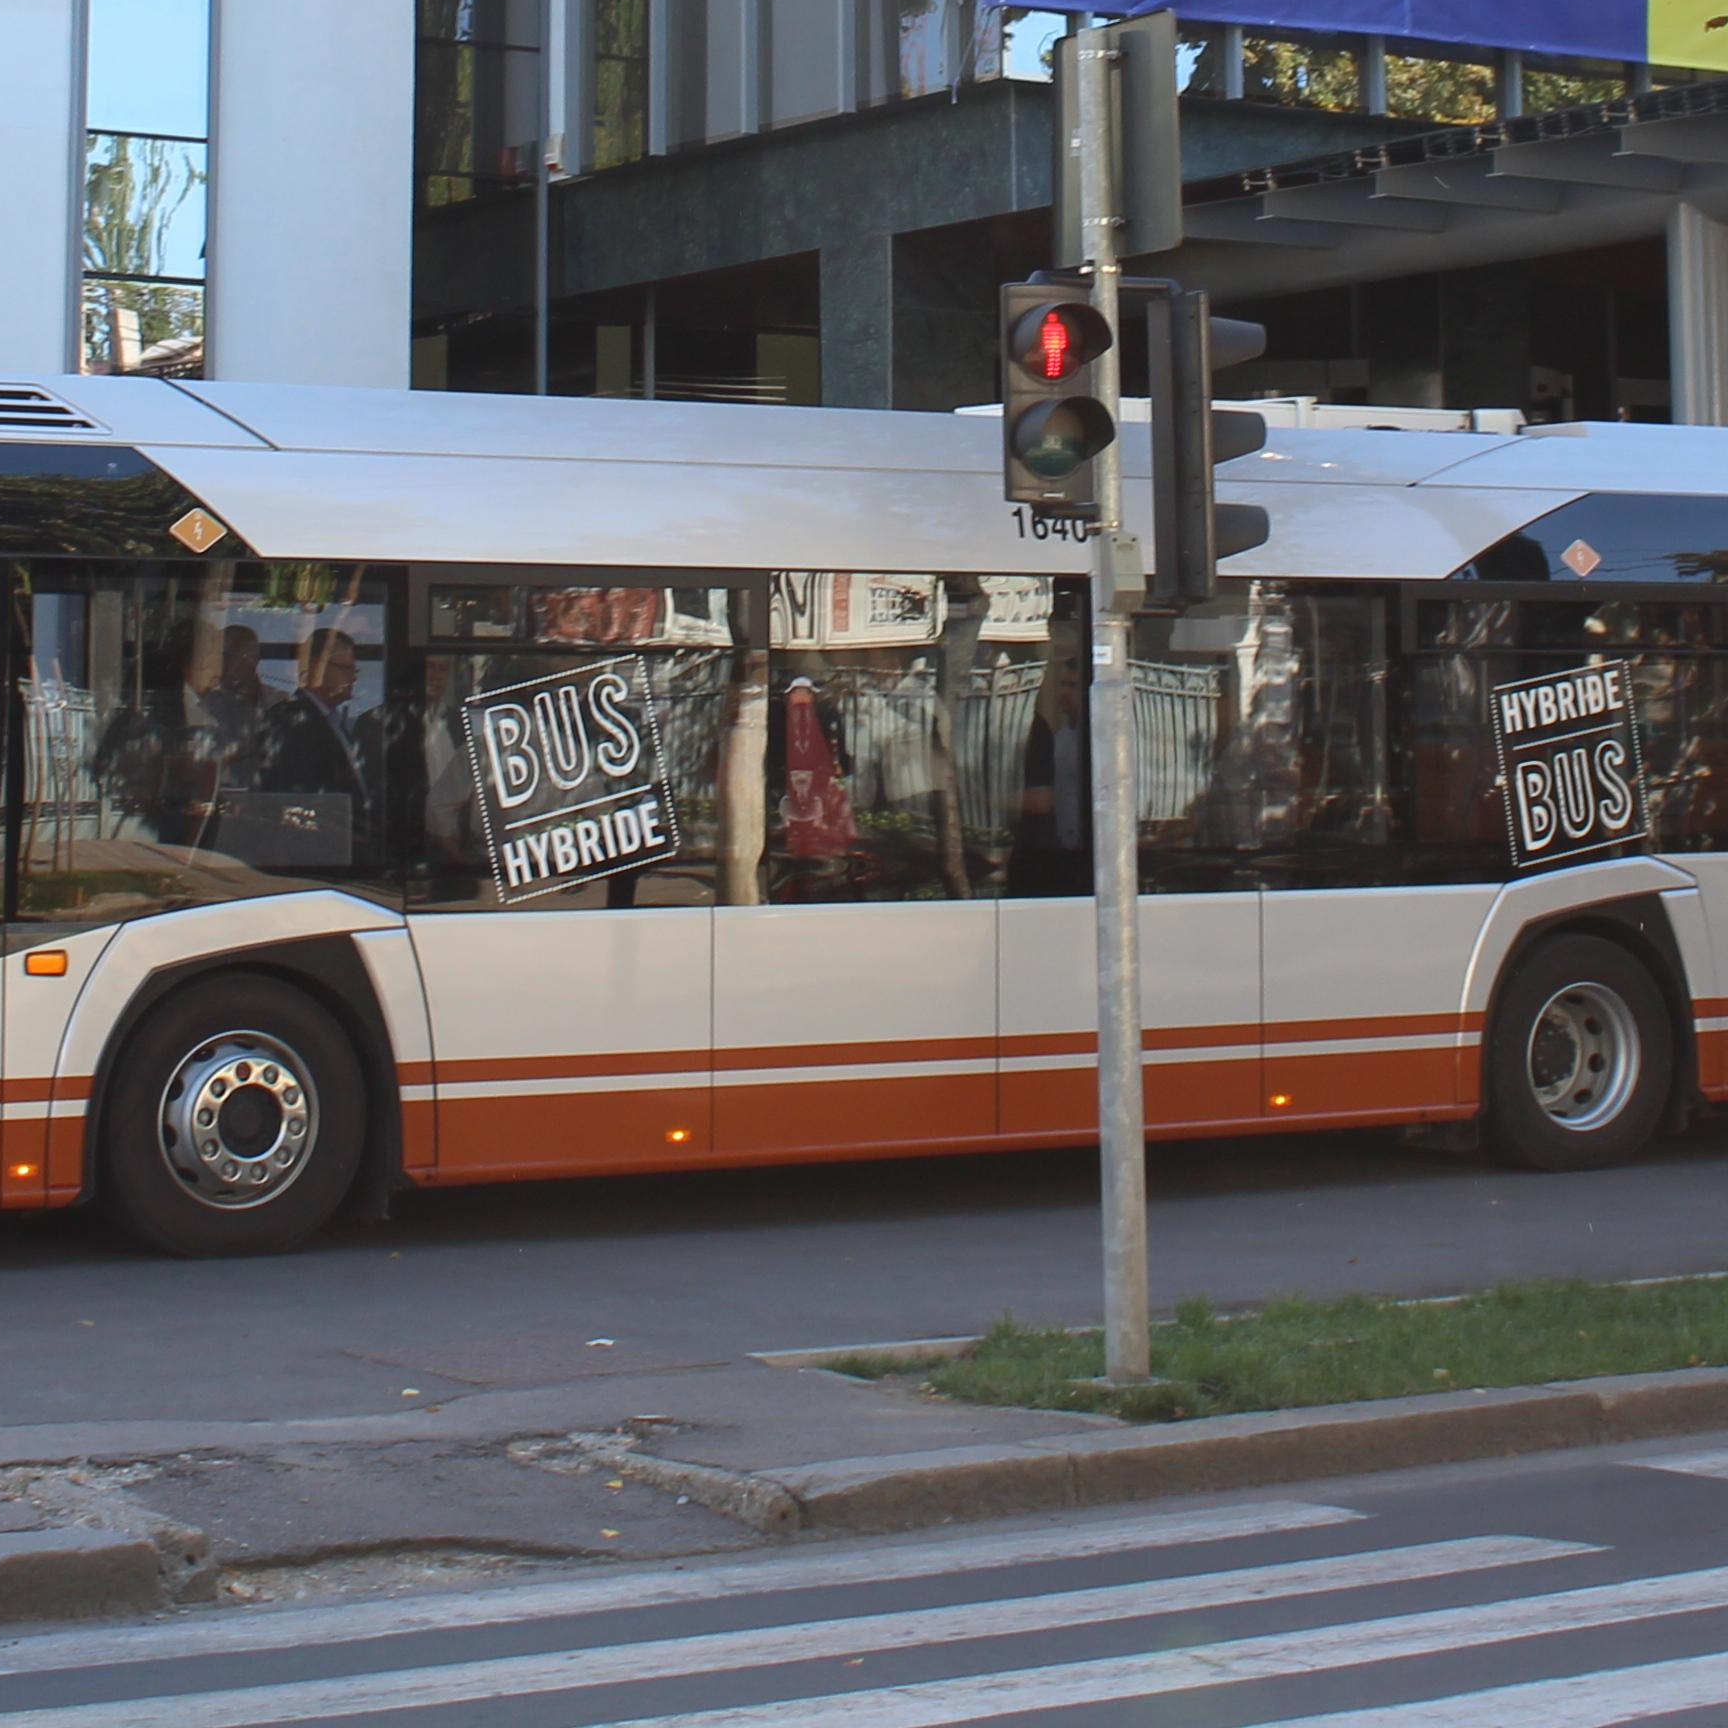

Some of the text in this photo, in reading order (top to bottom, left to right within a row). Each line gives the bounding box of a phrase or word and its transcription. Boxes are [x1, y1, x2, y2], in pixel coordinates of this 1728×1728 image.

[483, 673, 640, 809] BUS
[1500, 670, 1625, 735] HYBRIDE
[502, 800, 666, 888] HYBRIDE
[1515, 739, 1633, 852] BUS
